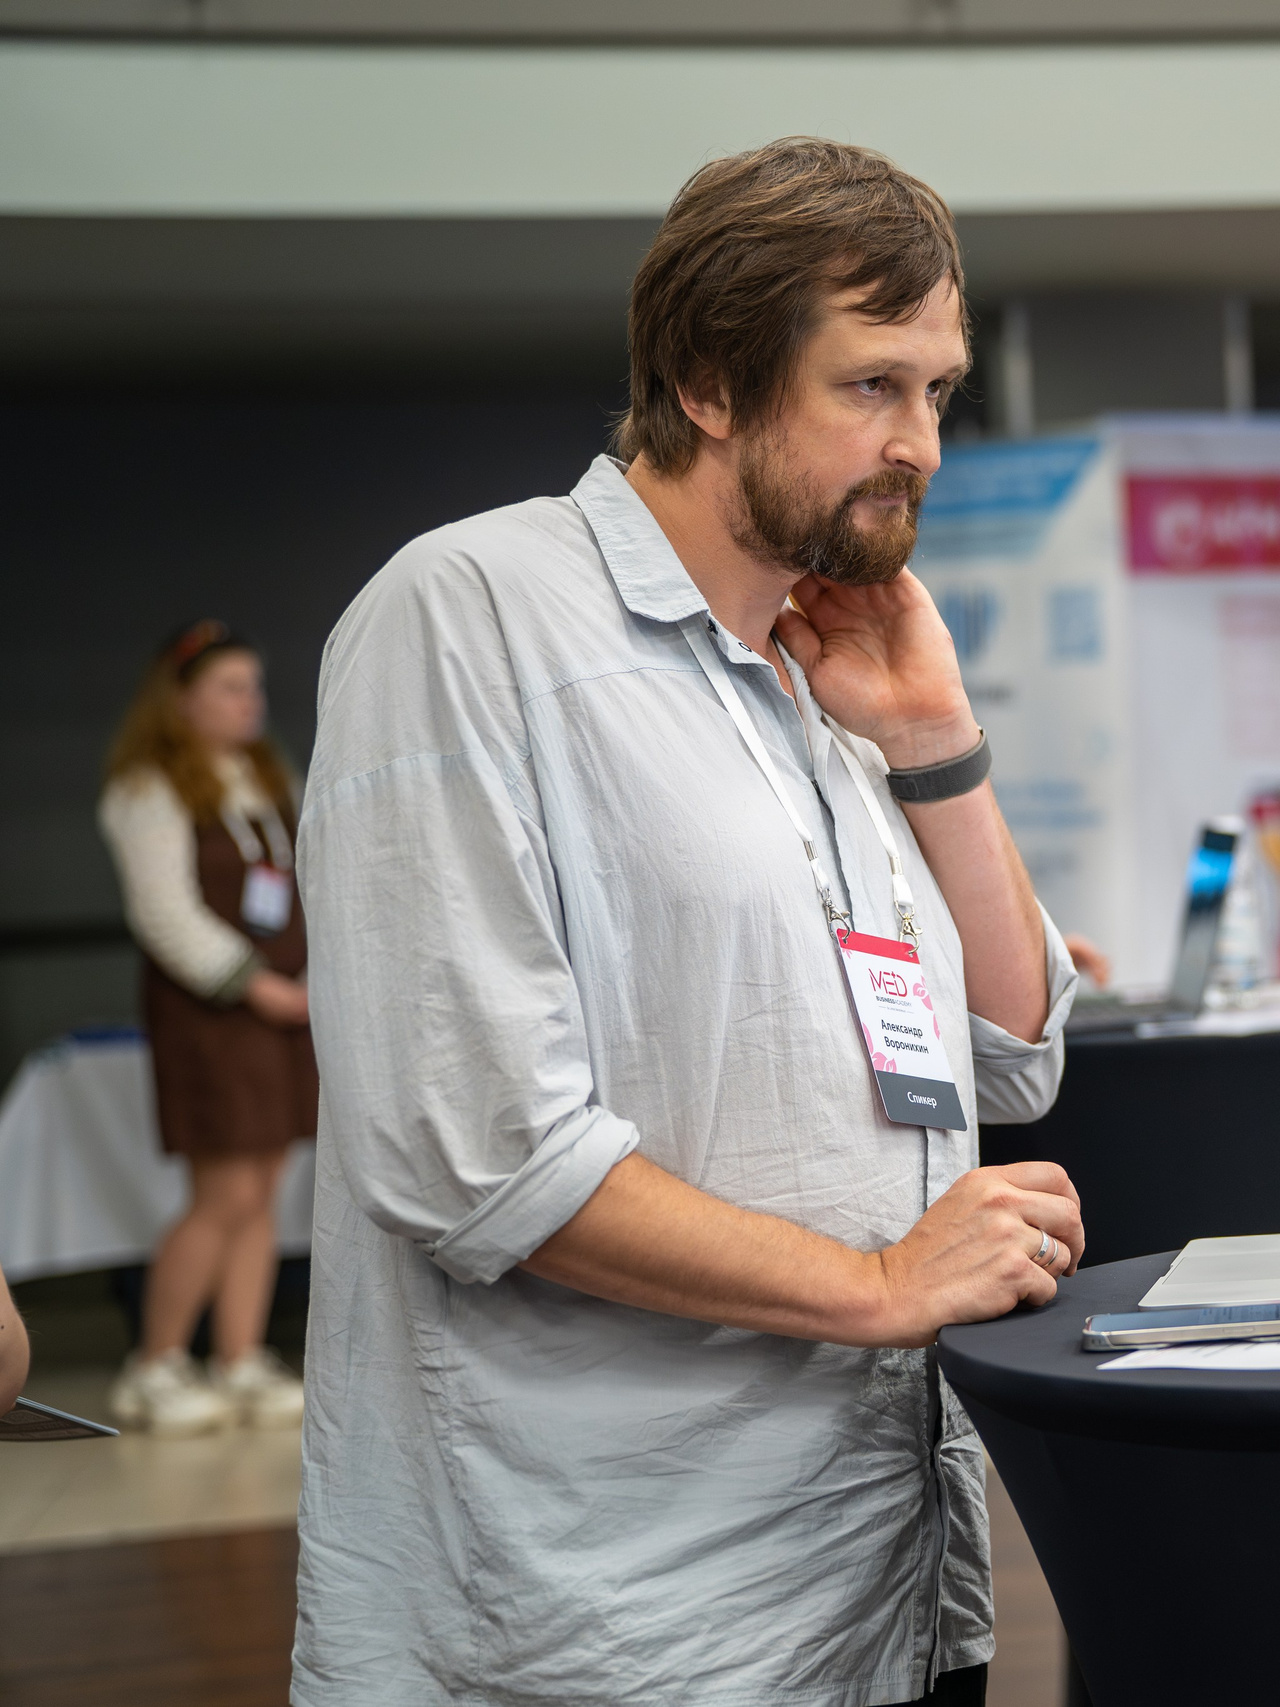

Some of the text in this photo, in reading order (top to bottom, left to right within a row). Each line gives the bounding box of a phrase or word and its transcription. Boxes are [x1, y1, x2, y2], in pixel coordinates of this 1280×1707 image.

[868, 968, 908, 997] MED
[881, 1019, 924, 1039] Александр
[884, 1036, 930, 1054] Воронихин
[907, 1091, 938, 1108] Спикер
